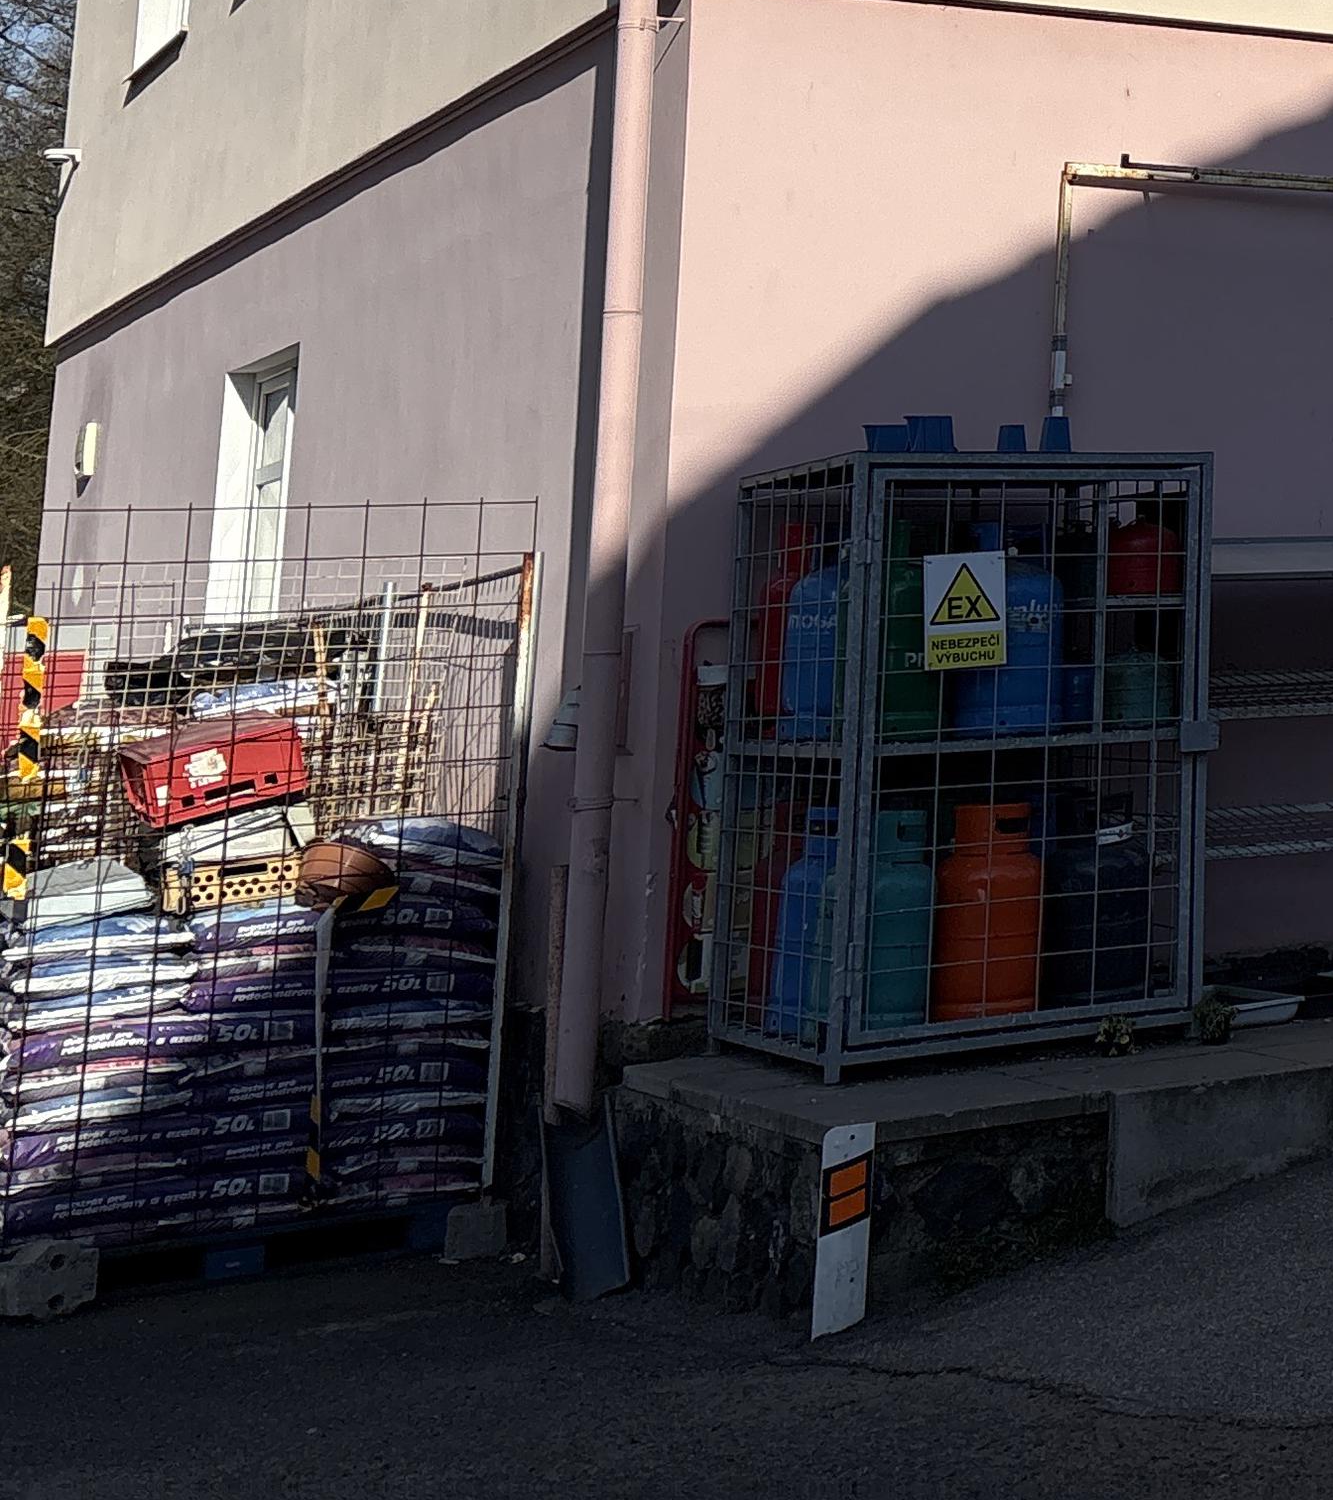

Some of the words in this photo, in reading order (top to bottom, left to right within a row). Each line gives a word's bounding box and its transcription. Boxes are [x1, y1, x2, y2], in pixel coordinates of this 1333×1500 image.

[948, 595, 983, 619] EX
[931, 633, 1000, 651] NEBEZPEČÍ
[936, 649, 995, 664] VÝBUCHU
